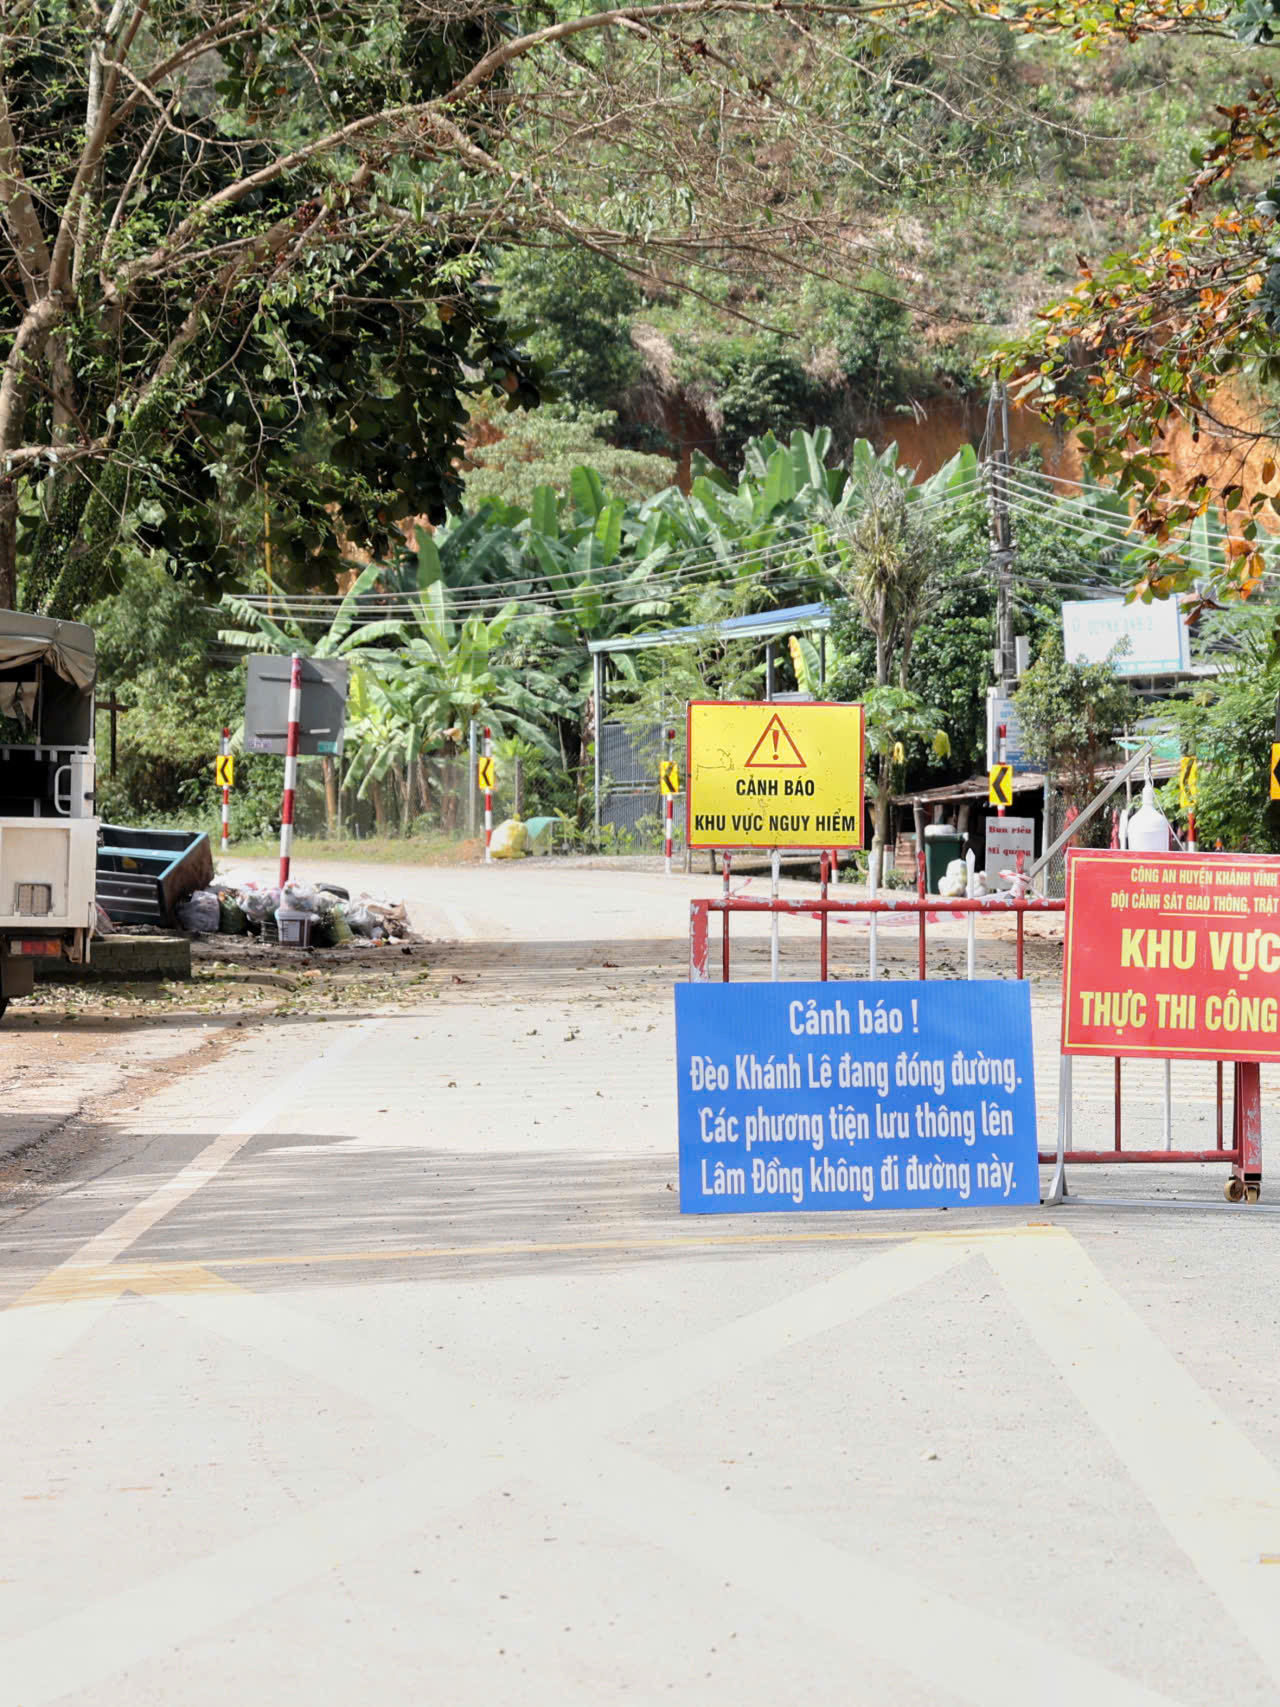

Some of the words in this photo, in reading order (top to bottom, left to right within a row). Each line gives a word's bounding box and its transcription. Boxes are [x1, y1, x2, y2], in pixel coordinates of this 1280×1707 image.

[736, 774, 779, 796] CẢNH
[784, 775, 815, 797] BÁO
[694, 814, 726, 831] KHU
[731, 812, 763, 835] VỰC
[768, 814, 811, 832] NGUY
[815, 807, 856, 832] HIỂM
[1130, 865, 1159, 884] CÔNG
[1162, 868, 1177, 884] AN
[1179, 866, 1213, 888] HUYỆN
[1215, 867, 1251, 887] KHÁNH
[1253, 869, 1278, 888] VĨNH
[1111, 889, 1129, 912] ĐỘI
[1131, 888, 1160, 910] CẢNH
[1163, 890, 1184, 911] SÁT
[1186, 894, 1210, 911] GIAO
[1213, 893, 1250, 914] THÔNG,
[1253, 894, 1280, 917] TRẬT
[1120, 928, 1197, 970] KHU
[789, 999, 851, 1036] Cảnh
[858, 999, 904, 1035] báo
[1079, 989, 1147, 1035] THỰC
[1155, 993, 1196, 1030] THI
[1204, 988, 1278, 1033] CÔNG
[689, 1055, 729, 1091] Đèo
[735, 1053, 801, 1090] Khánh
[808, 1052, 832, 1089] Lê
[838, 1052, 889, 1098] đang
[895, 1051, 946, 1096] đóng
[951, 1050, 1023, 1094] đường.
[699, 1106, 740, 1144] Các
[745, 1105, 824, 1152] phương
[828, 1103, 870, 1147] tiện
[875, 1103, 910, 1139] lưu
[915, 1101, 976, 1147] thông
[981, 1100, 1014, 1137] lên
[701, 1158, 745, 1196] Lâm
[751, 1156, 804, 1204] Đồng
[810, 1156, 874, 1203] không
[880, 1154, 899, 1193] đi
[905, 1154, 971, 1200] đường
[976, 1152, 1017, 1198] này.
